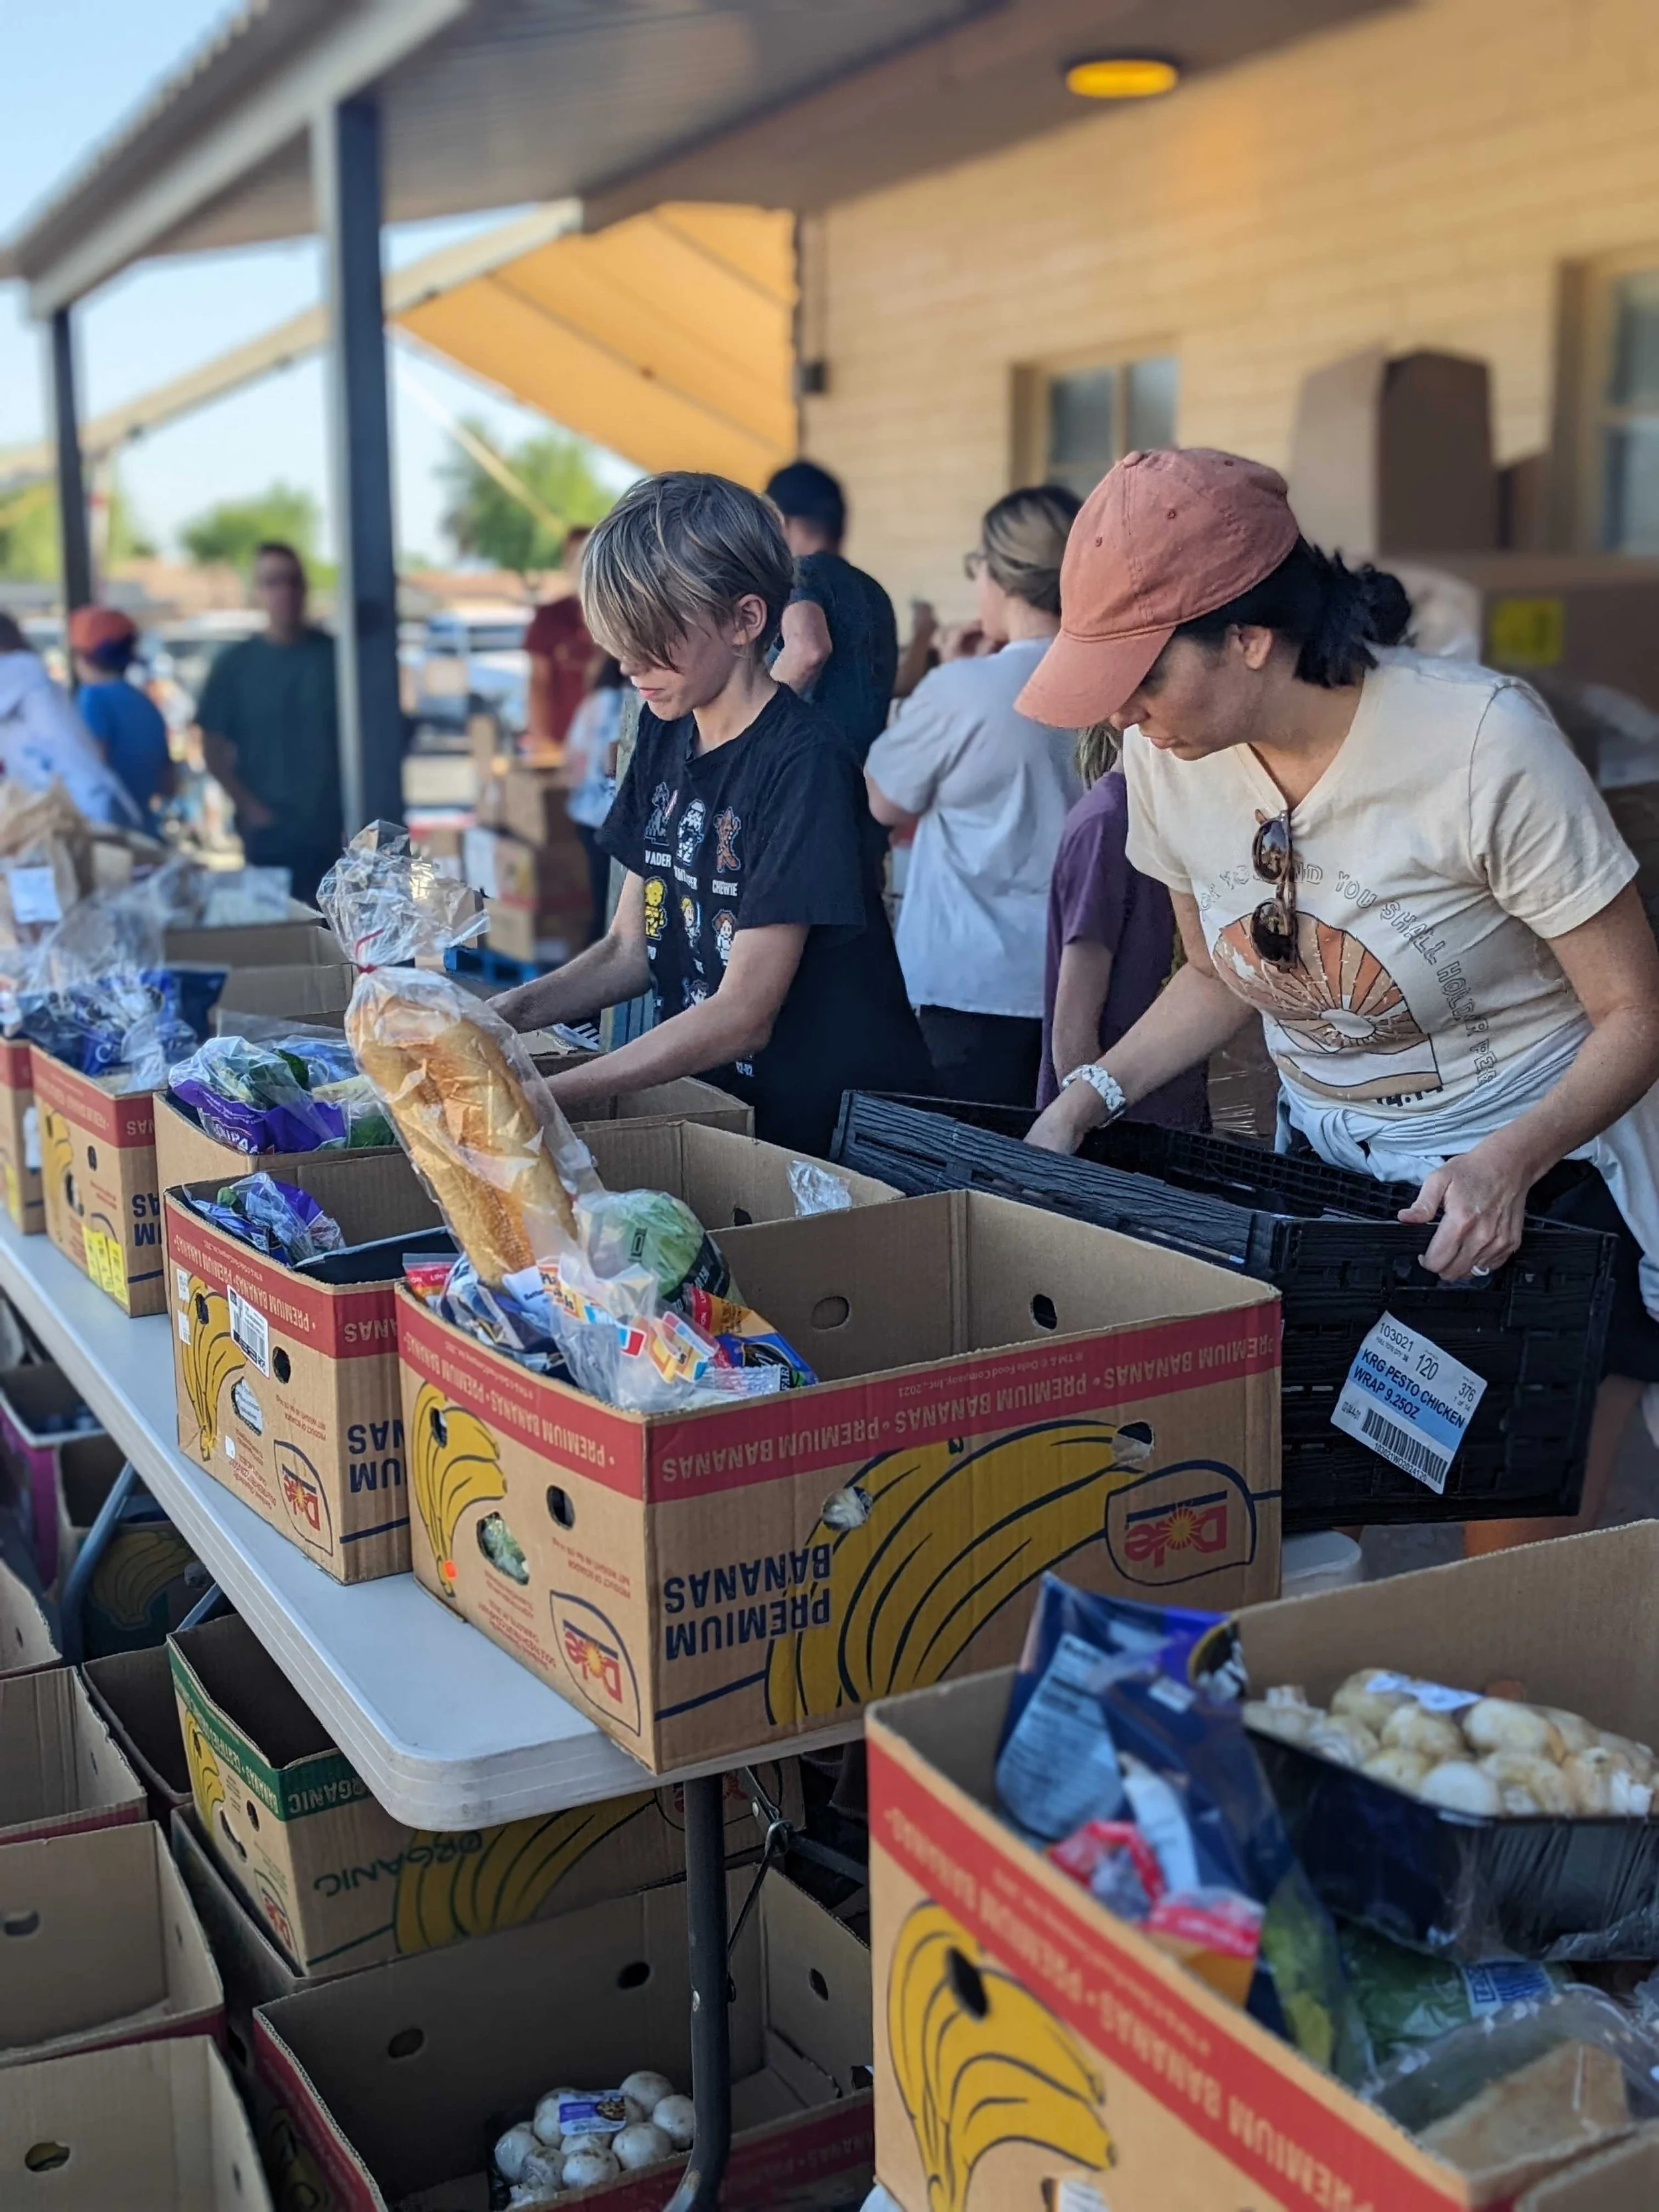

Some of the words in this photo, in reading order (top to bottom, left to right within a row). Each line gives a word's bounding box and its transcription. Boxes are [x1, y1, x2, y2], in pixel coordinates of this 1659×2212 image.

[645, 850, 672, 867] VADER
[712, 879, 738, 896] CHEWIE
[1294, 862, 1323, 885] ND
[1335, 871, 1378, 908] YOU
[1380, 901, 1445, 964] SHALL
[236, 1274, 268, 1310] BANANAS
[269, 1295, 309, 1332] PREMIUM
[1380, 1322, 1414, 1352] 103021
[444, 1361, 484, 1402] PREMIUM
[991, 1364, 1015, 1378] Food
[1106, 1352, 1192, 1389] BANANAS
[1353, 1364, 1385, 1393] WRAP
[1414, 1353, 1439, 1381] 120
[897, 1383, 921, 1397] 2021
[997, 1372, 1086, 1410] PREMIUM
[1361, 1348, 1387, 1372] KRG
[1384, 1366, 1420, 1396] PESTO
[1419, 1390, 1465, 1429] CHICKEN
[1458, 1382, 1477, 1402] 376
[491, 1388, 540, 1438] BANANAS
[896, 1392, 990, 1434] BANANAS
[543, 1418, 605, 1467] PREMIUM
[779, 1417, 878, 1455] PREMIUM
[662, 1438, 771, 1482] BANANAS
[283, 1473, 321, 1532] Dole
[1125, 1505, 1226, 1568] Dole
[664, 1543, 830, 1613] BANANAS
[665, 1586, 831, 1662] PREMIUM
[564, 1631, 623, 1704] Dole
[288, 1777, 364, 1814] RGANIC
[314, 1830, 482, 1897] ORGANIC
